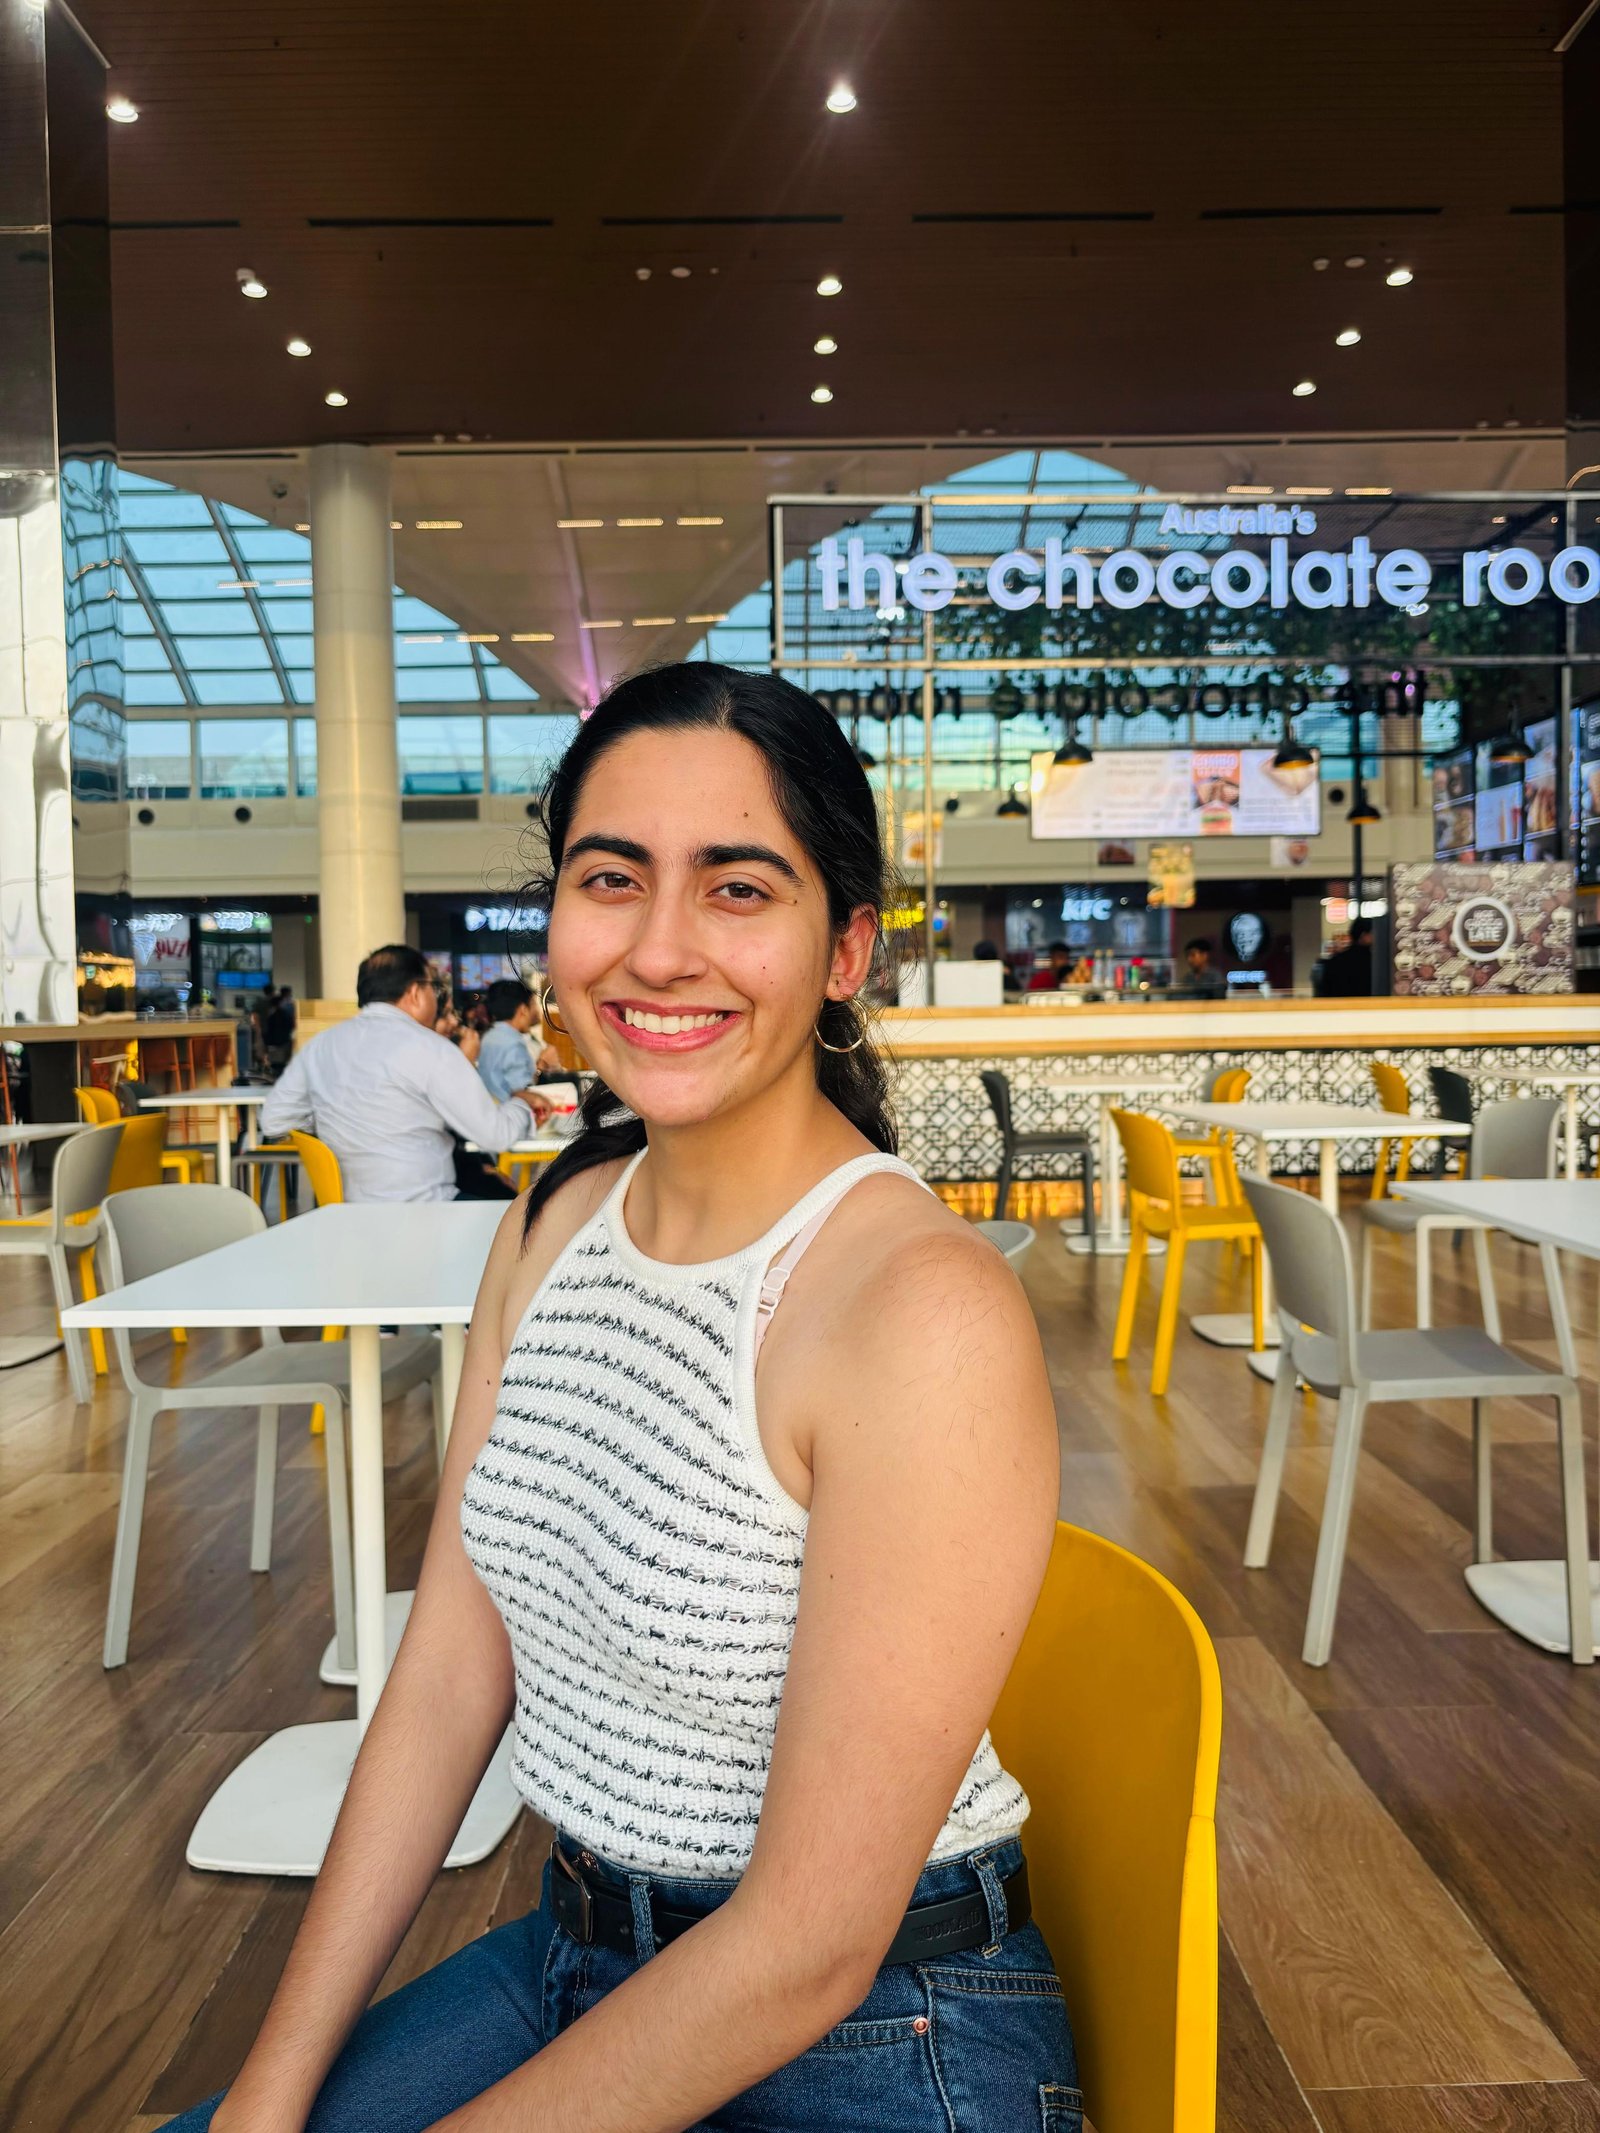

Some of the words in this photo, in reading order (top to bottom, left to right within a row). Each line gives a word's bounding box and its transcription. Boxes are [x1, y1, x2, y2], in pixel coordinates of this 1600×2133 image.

[1158, 503, 1318, 536] Australia's
[816, 536, 958, 611] the
[986, 536, 1432, 611] chocolate
[1061, 898, 1114, 921] KFC
